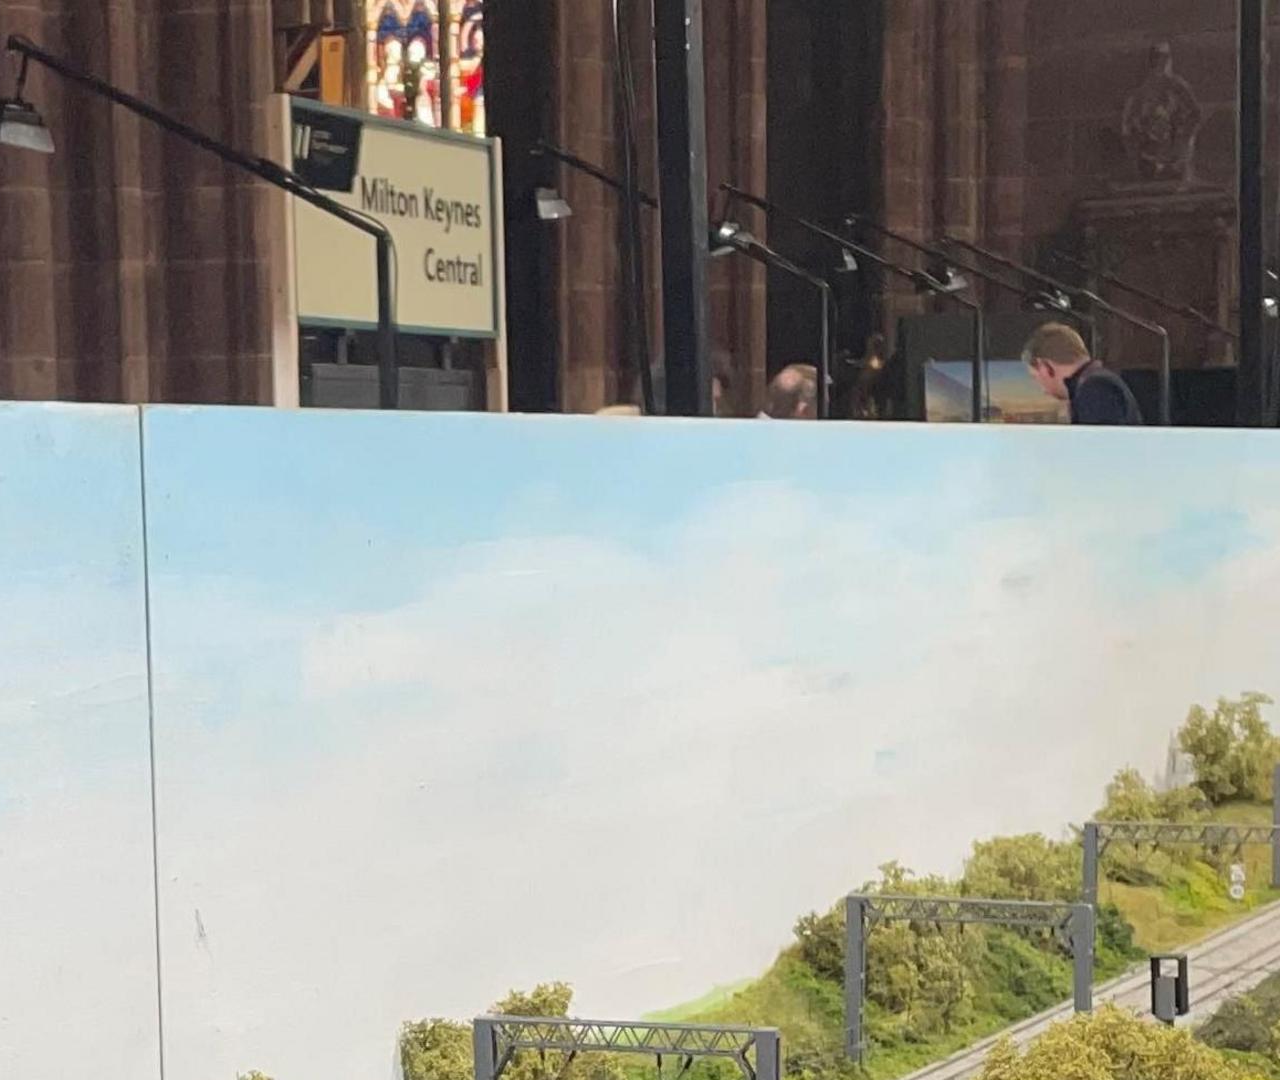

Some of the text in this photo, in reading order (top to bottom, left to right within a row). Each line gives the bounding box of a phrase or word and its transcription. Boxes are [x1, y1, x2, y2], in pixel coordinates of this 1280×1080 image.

[361, 175, 481, 234] Milton Keynes
[424, 247, 482, 286] Central
